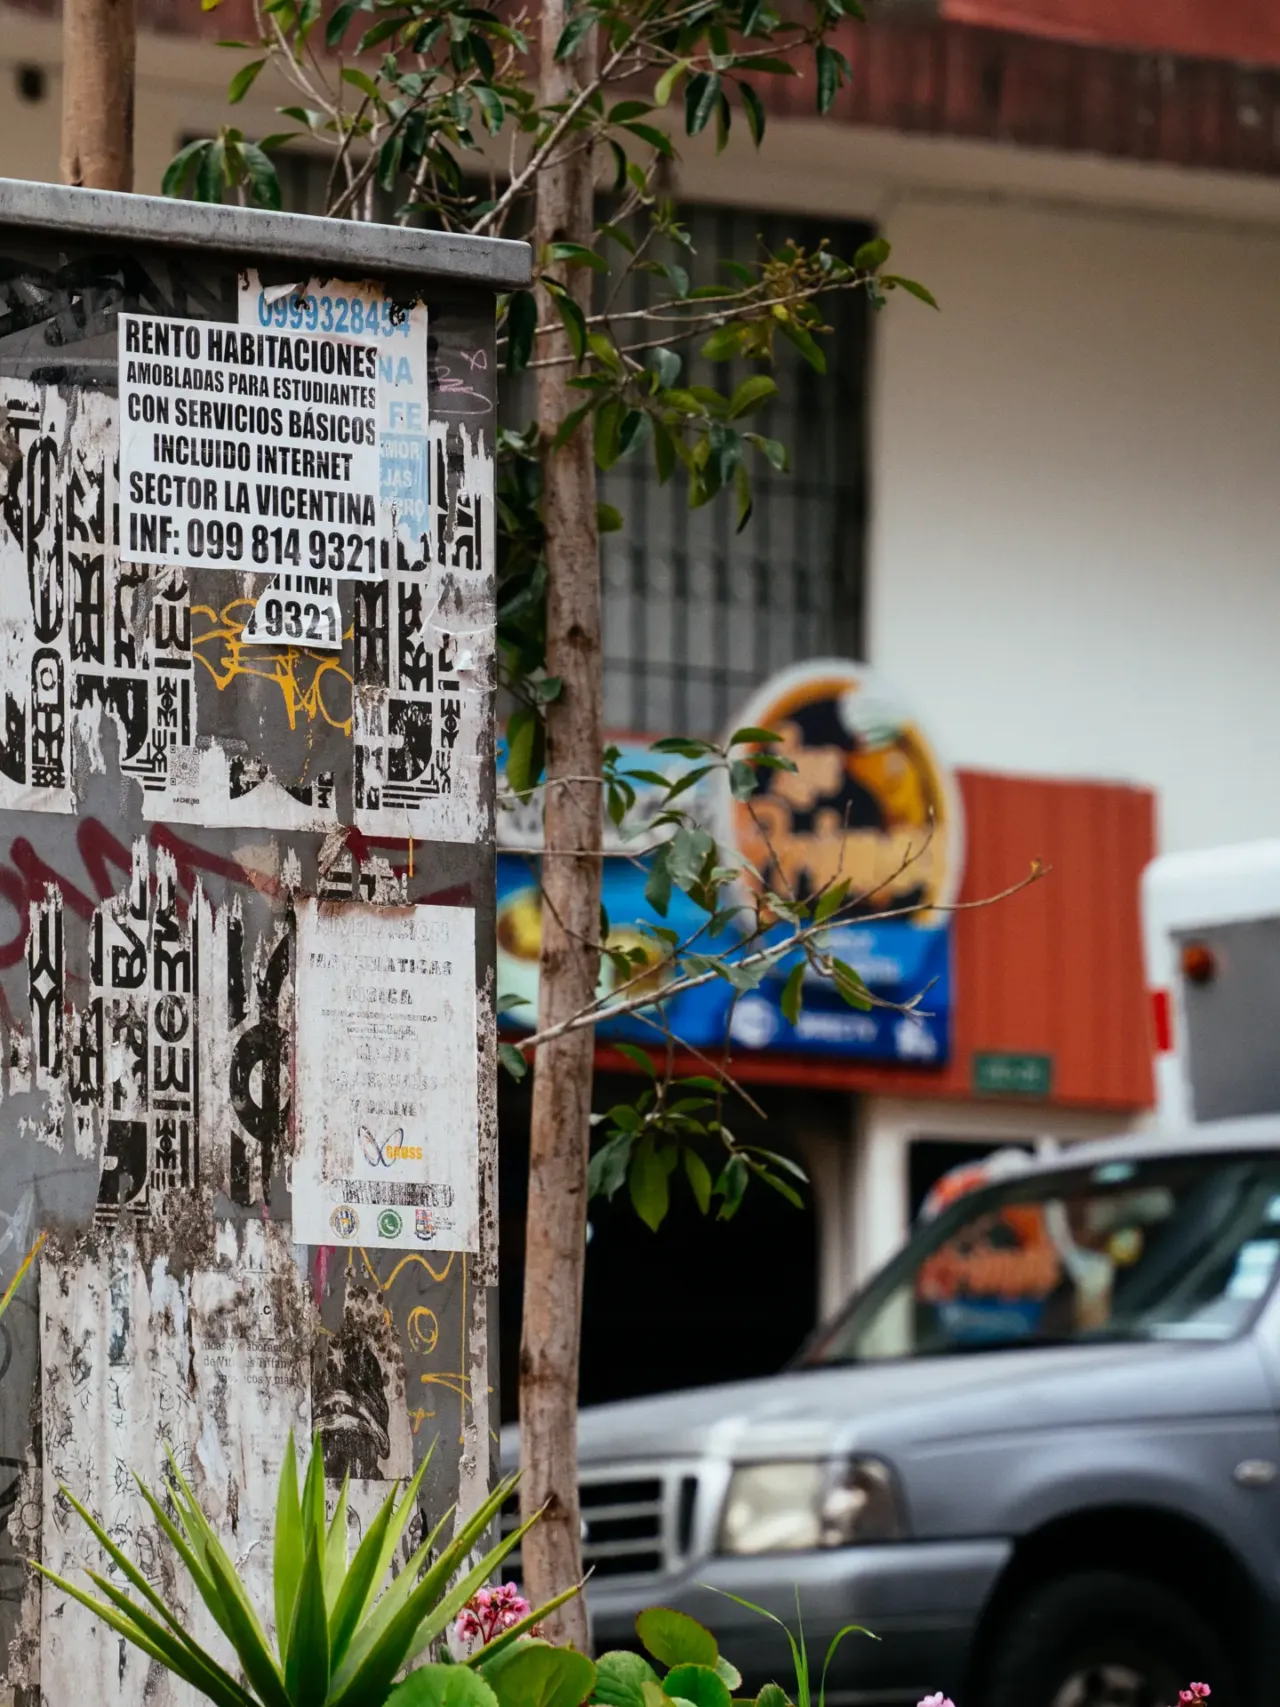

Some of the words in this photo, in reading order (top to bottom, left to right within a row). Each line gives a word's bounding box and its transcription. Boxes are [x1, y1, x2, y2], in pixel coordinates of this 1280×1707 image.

[126, 318, 201, 360] RENTO
[208, 328, 378, 380] HABITACIONES
[126, 360, 224, 394] AMOBLADAS
[228, 372, 269, 398] PARA
[273, 377, 376, 410] ESTUDIANTES
[128, 393, 169, 425] CON
[175, 397, 283, 438] SERVICIOS
[289, 407, 376, 446] BÁSICOS
[153, 433, 251, 472] INCLUIDO
[256, 444, 353, 481] INTERNET
[130, 470, 218, 511] SECTOR
[225, 480, 250, 514] LA
[256, 484, 376, 527] VICENTINA
[130, 512, 180, 555] INF:
[187, 518, 243, 561] 099
[251, 524, 301, 567] 814
[309, 530, 376, 574] 9321
[265, 598, 337, 642] 9321
